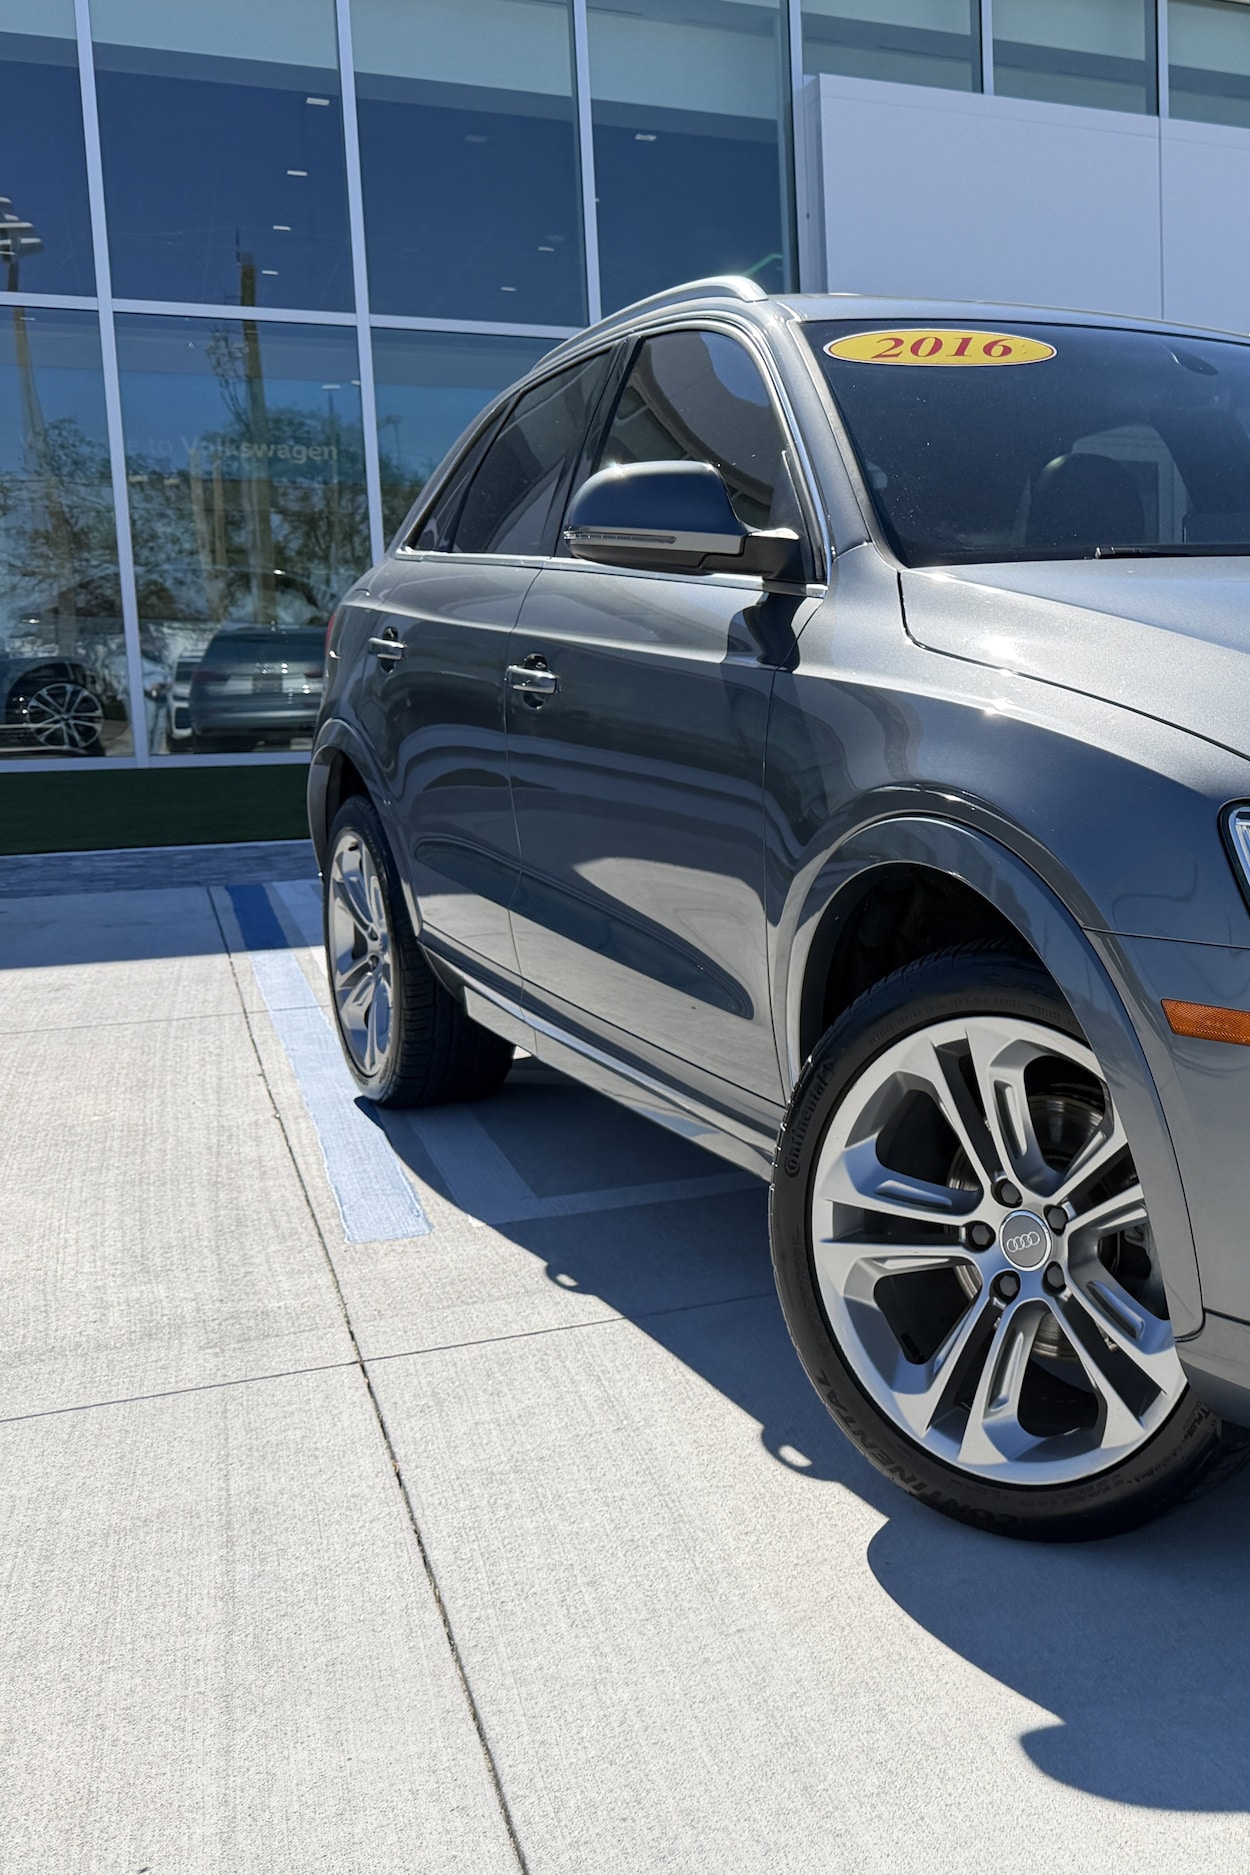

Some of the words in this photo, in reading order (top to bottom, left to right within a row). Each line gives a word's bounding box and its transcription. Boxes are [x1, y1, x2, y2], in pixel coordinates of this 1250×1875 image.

[871, 336, 1013, 360] 2016
[180, 435, 338, 464] Volkswagen
[784, 1074, 830, 1177] Continental
